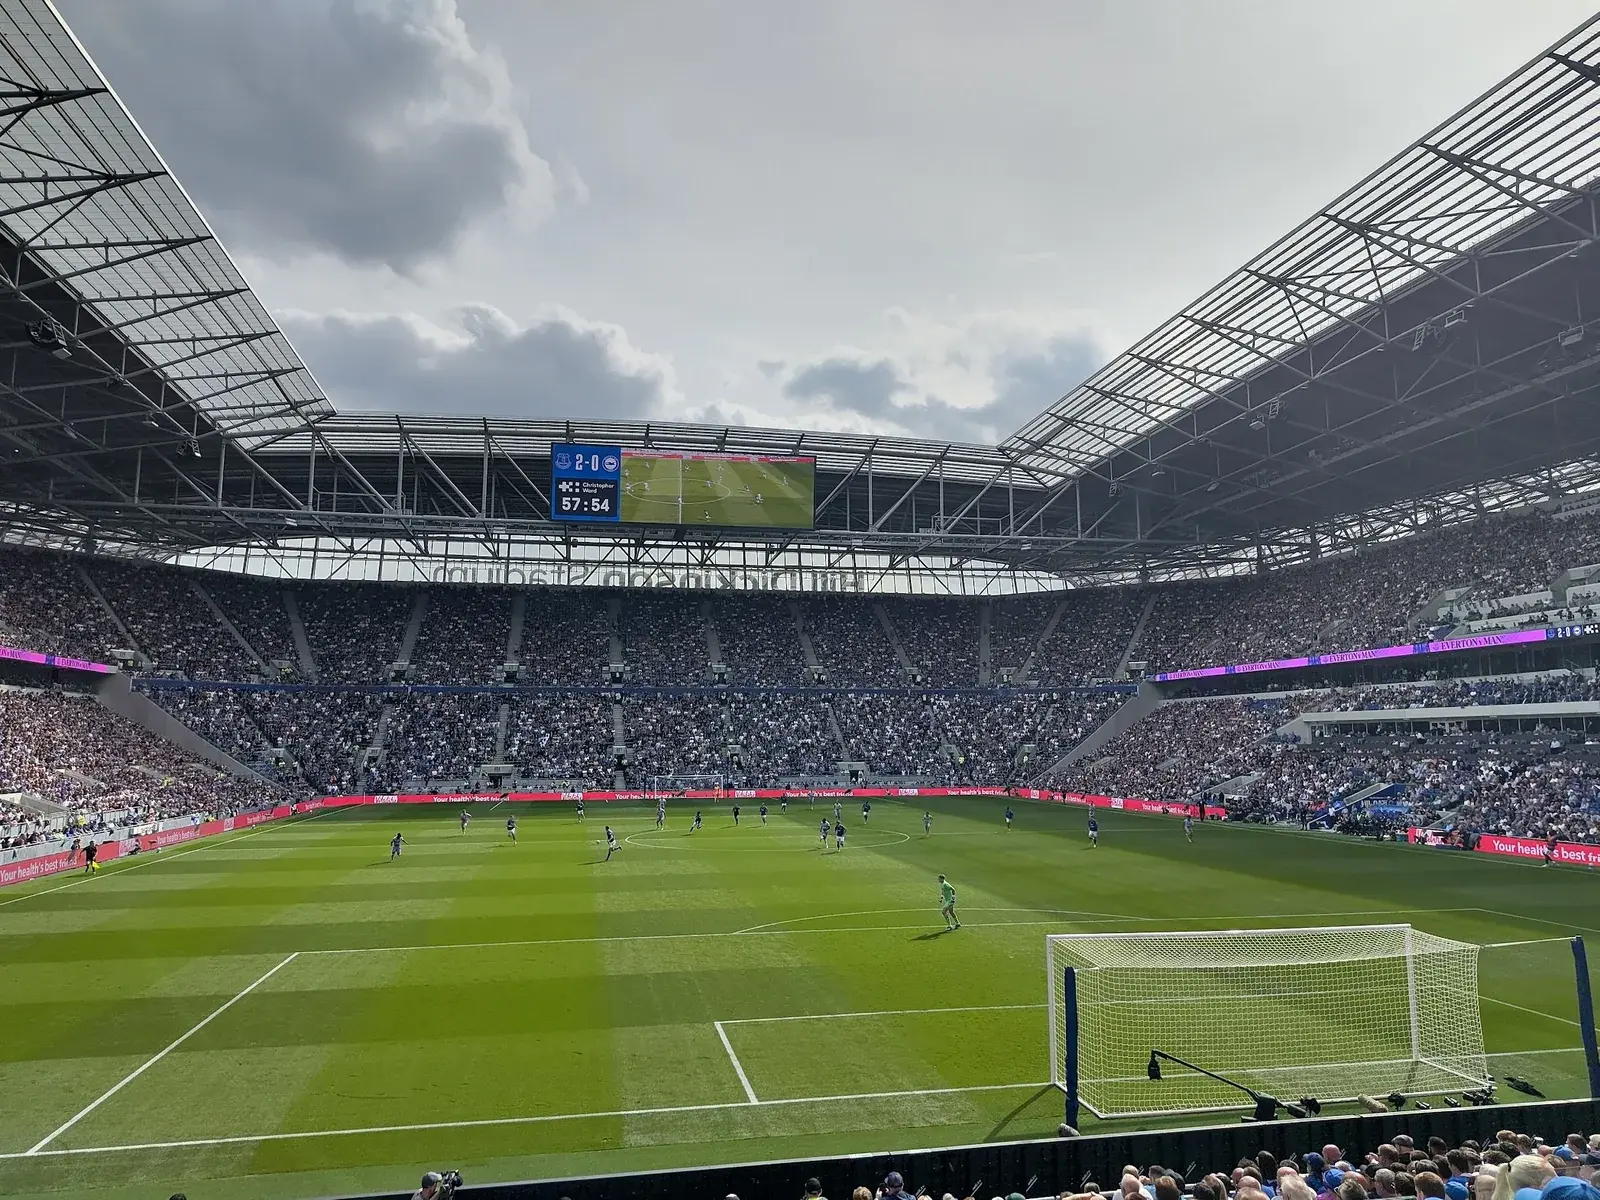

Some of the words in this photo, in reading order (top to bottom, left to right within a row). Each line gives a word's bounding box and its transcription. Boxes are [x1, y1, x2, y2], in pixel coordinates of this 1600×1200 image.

[575, 453, 599, 471] 2-0
[582, 481, 615, 489] Christopher
[561, 497, 610, 512] 57:54
[1557, 626, 1571, 638] 2-0
[1441, 637, 1478, 650] EVERTON
[1493, 840, 1516, 854] Your
[1561, 847, 1586, 861] best
[0, 869, 17, 882] Your
[17, 861, 44, 879] health's
[44, 859, 58, 872] best
